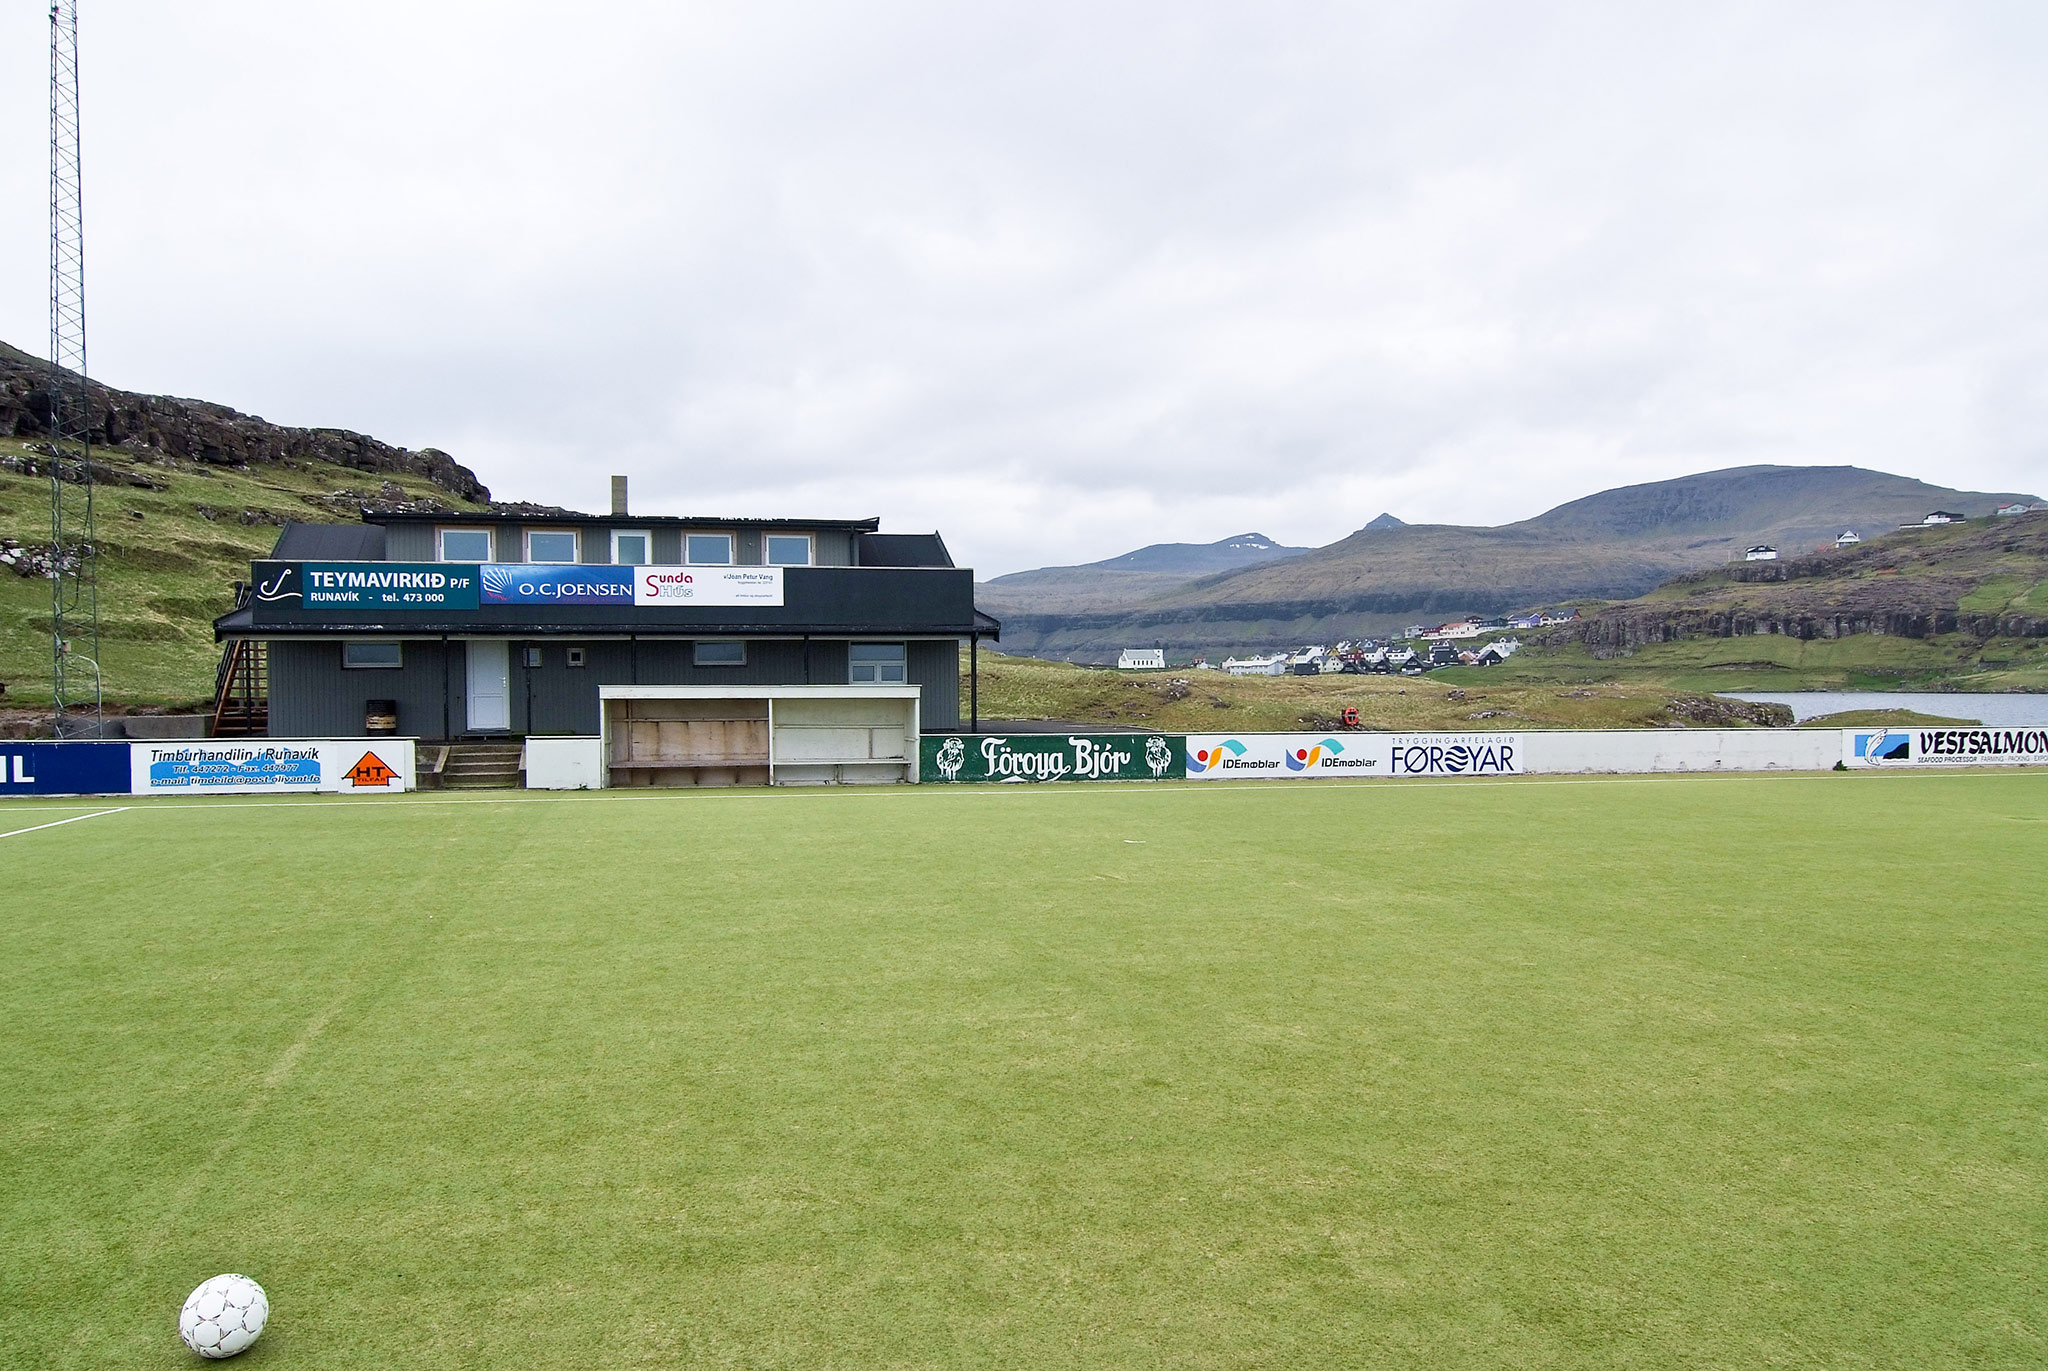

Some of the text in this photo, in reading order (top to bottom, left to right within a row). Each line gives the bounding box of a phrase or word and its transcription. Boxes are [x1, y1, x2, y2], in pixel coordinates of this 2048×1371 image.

[310, 572, 470, 589] TEYMAVIRKIÐ P/F
[646, 572, 693, 597] Sunda
[310, 591, 359, 602] RUNAVÍK
[382, 593, 400, 602] tel.
[403, 593, 422, 602] 473
[424, 594, 445, 602] 000
[151, 748, 253, 762] Timburhandilin
[1068, 736, 1131, 778] Bjór
[192, 765, 229, 773] 447272
[238, 764, 260, 773] Fax.
[262, 763, 299, 772] 447977
[356, 766, 386, 777] HT
